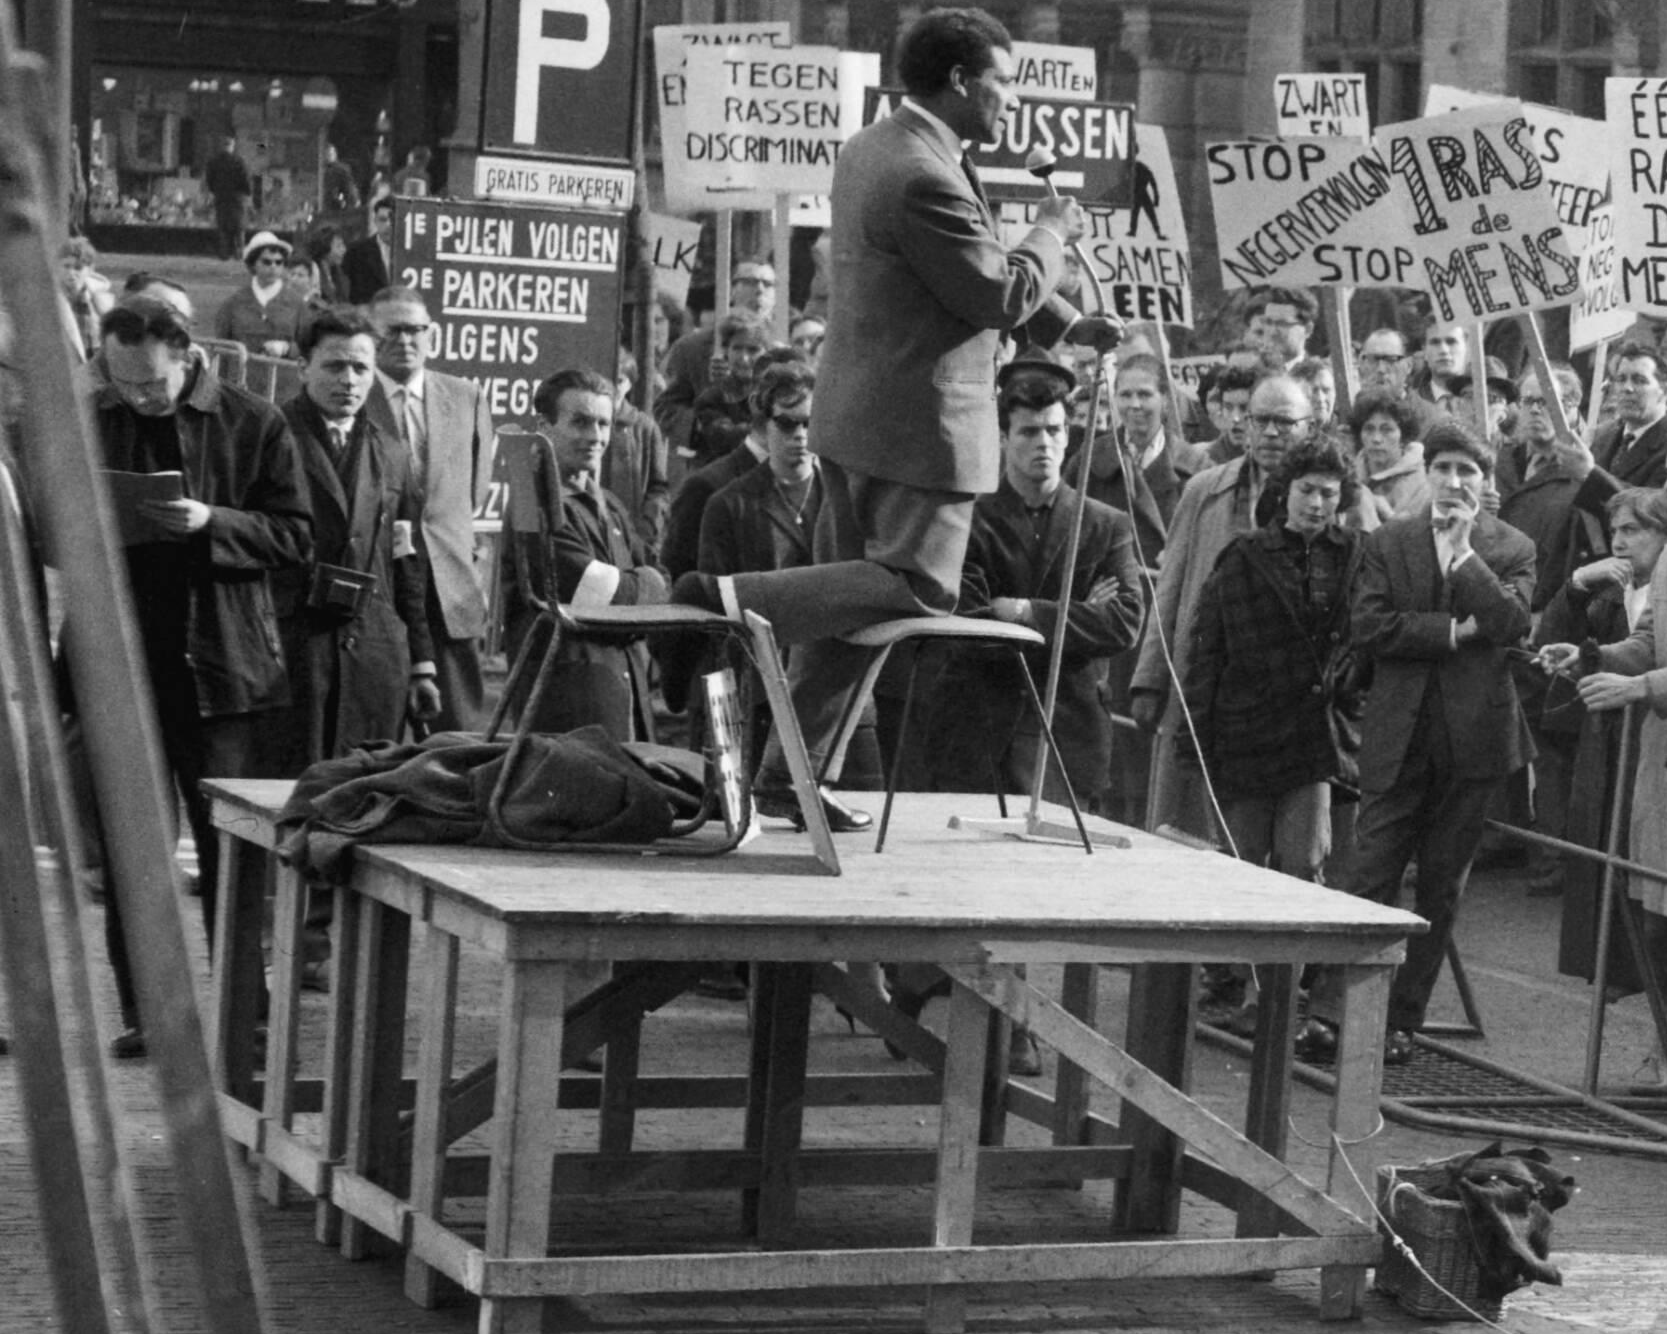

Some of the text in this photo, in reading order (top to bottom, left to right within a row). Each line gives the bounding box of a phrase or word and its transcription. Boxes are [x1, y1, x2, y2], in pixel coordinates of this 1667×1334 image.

[723, 60, 838, 91] TEGEN
[725, 96, 840, 128] RASSEN
[1279, 79, 1362, 117] ZWART
[1310, 120, 1342, 135] EN
[1207, 144, 1326, 184] STOP
[1391, 117, 1544, 235] 1 RAS
[486, 168, 624, 201] GRATIS PARKEREN
[1471, 203, 1513, 235] de
[529, 221, 619, 264] VOLGEN
[1092, 244, 1190, 286] SAMEN
[1313, 244, 1414, 283] STOP
[1423, 226, 1580, 322] MENS
[443, 269, 589, 314] PARKEREN
[1113, 284, 1185, 323] EEN
[429, 322, 538, 364] OLGENS
